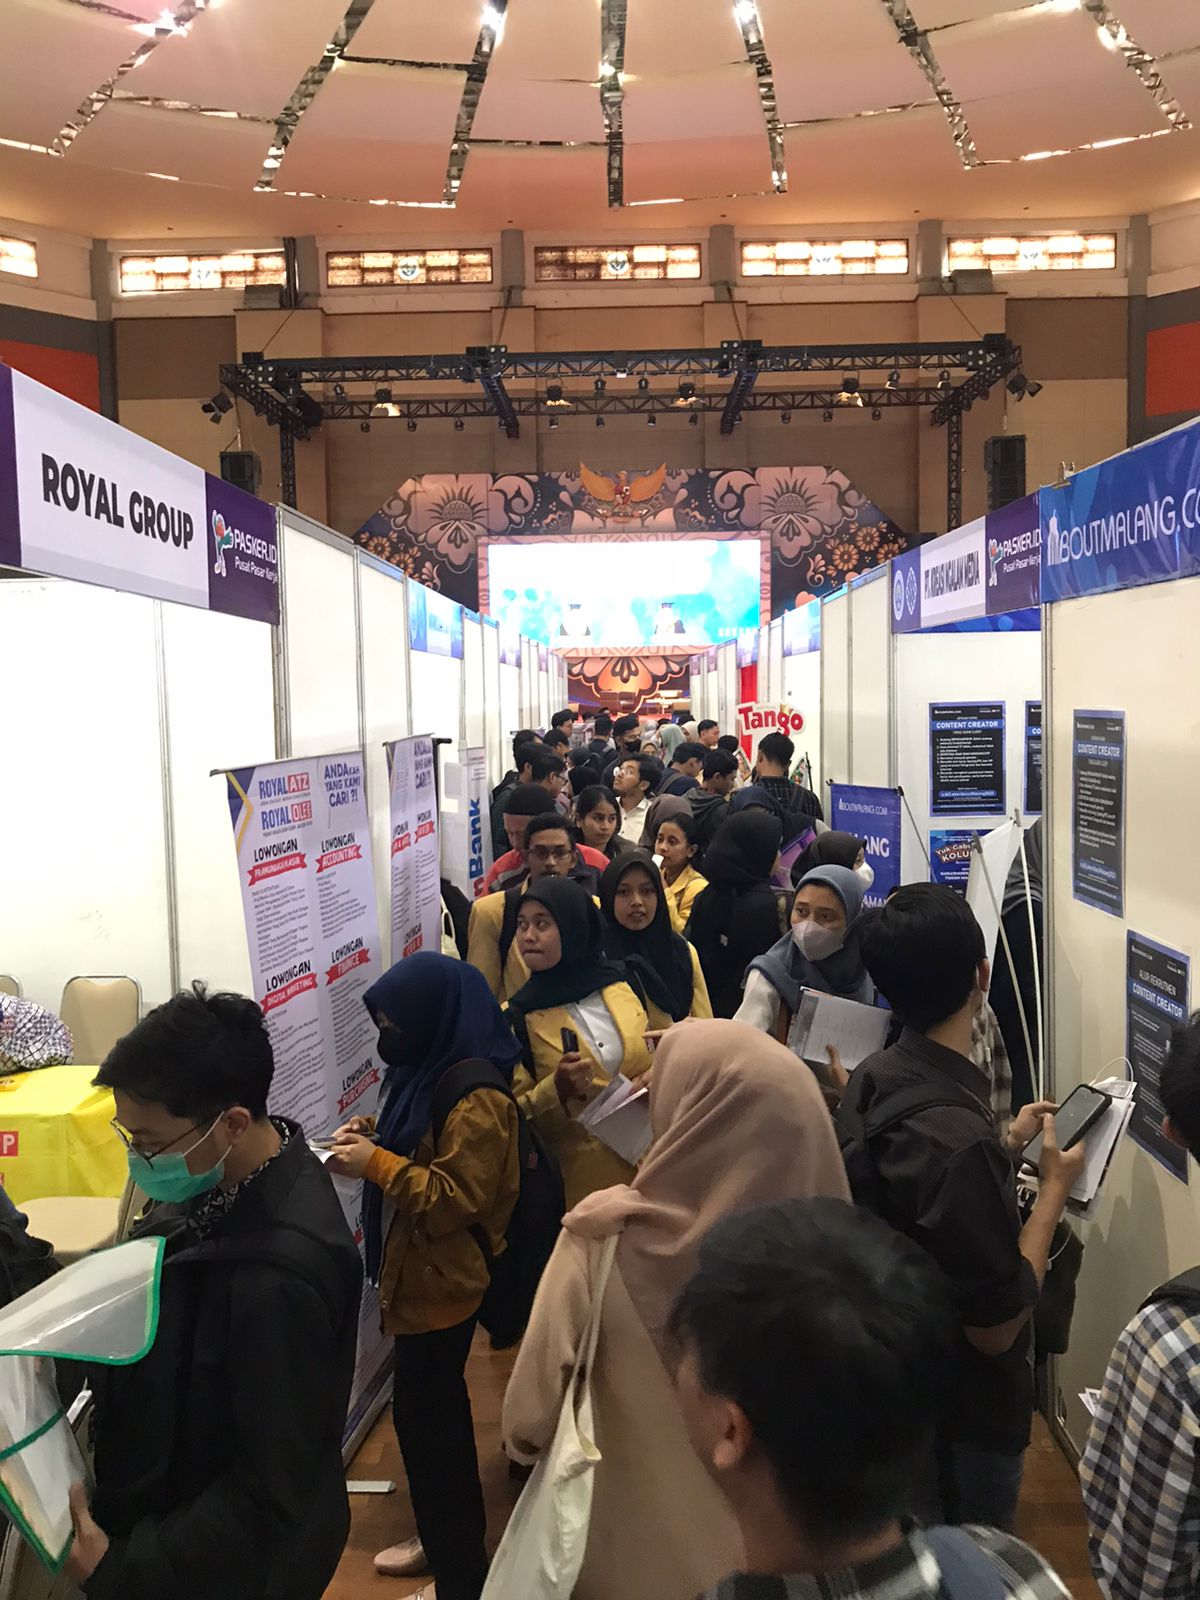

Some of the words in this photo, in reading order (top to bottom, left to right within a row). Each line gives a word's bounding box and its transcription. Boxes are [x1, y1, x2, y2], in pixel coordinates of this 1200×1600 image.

[41, 452, 124, 528] ROYAL
[129, 491, 194, 550] GROUP
[234, 528, 277, 564] PASKER.ID
[1003, 528, 1041, 558] PASKER.ID
[234, 555, 250, 573] Pusat
[250, 561, 265, 578] Pasar
[738, 705, 804, 737] Tango
[936, 721, 966, 729] CONTENT
[967, 720, 999, 728] CREATOR
[258, 776, 288, 800] ROYAL
[324, 779, 343, 792] YANG
[344, 776, 361, 788] KAMI
[329, 790, 349, 807] CARI
[261, 805, 291, 831] ROYAL
[254, 838, 298, 862] LOWONGAN
[321, 832, 356, 853] LOWONGAN
[331, 936, 364, 964] LOWONGAN
[265, 960, 311, 992] LOWONGAN
[1133, 982, 1156, 1004] CONTENT
[1157, 995, 1183, 1019] CREATOR
[342, 1057, 373, 1091] LOWONGAN
